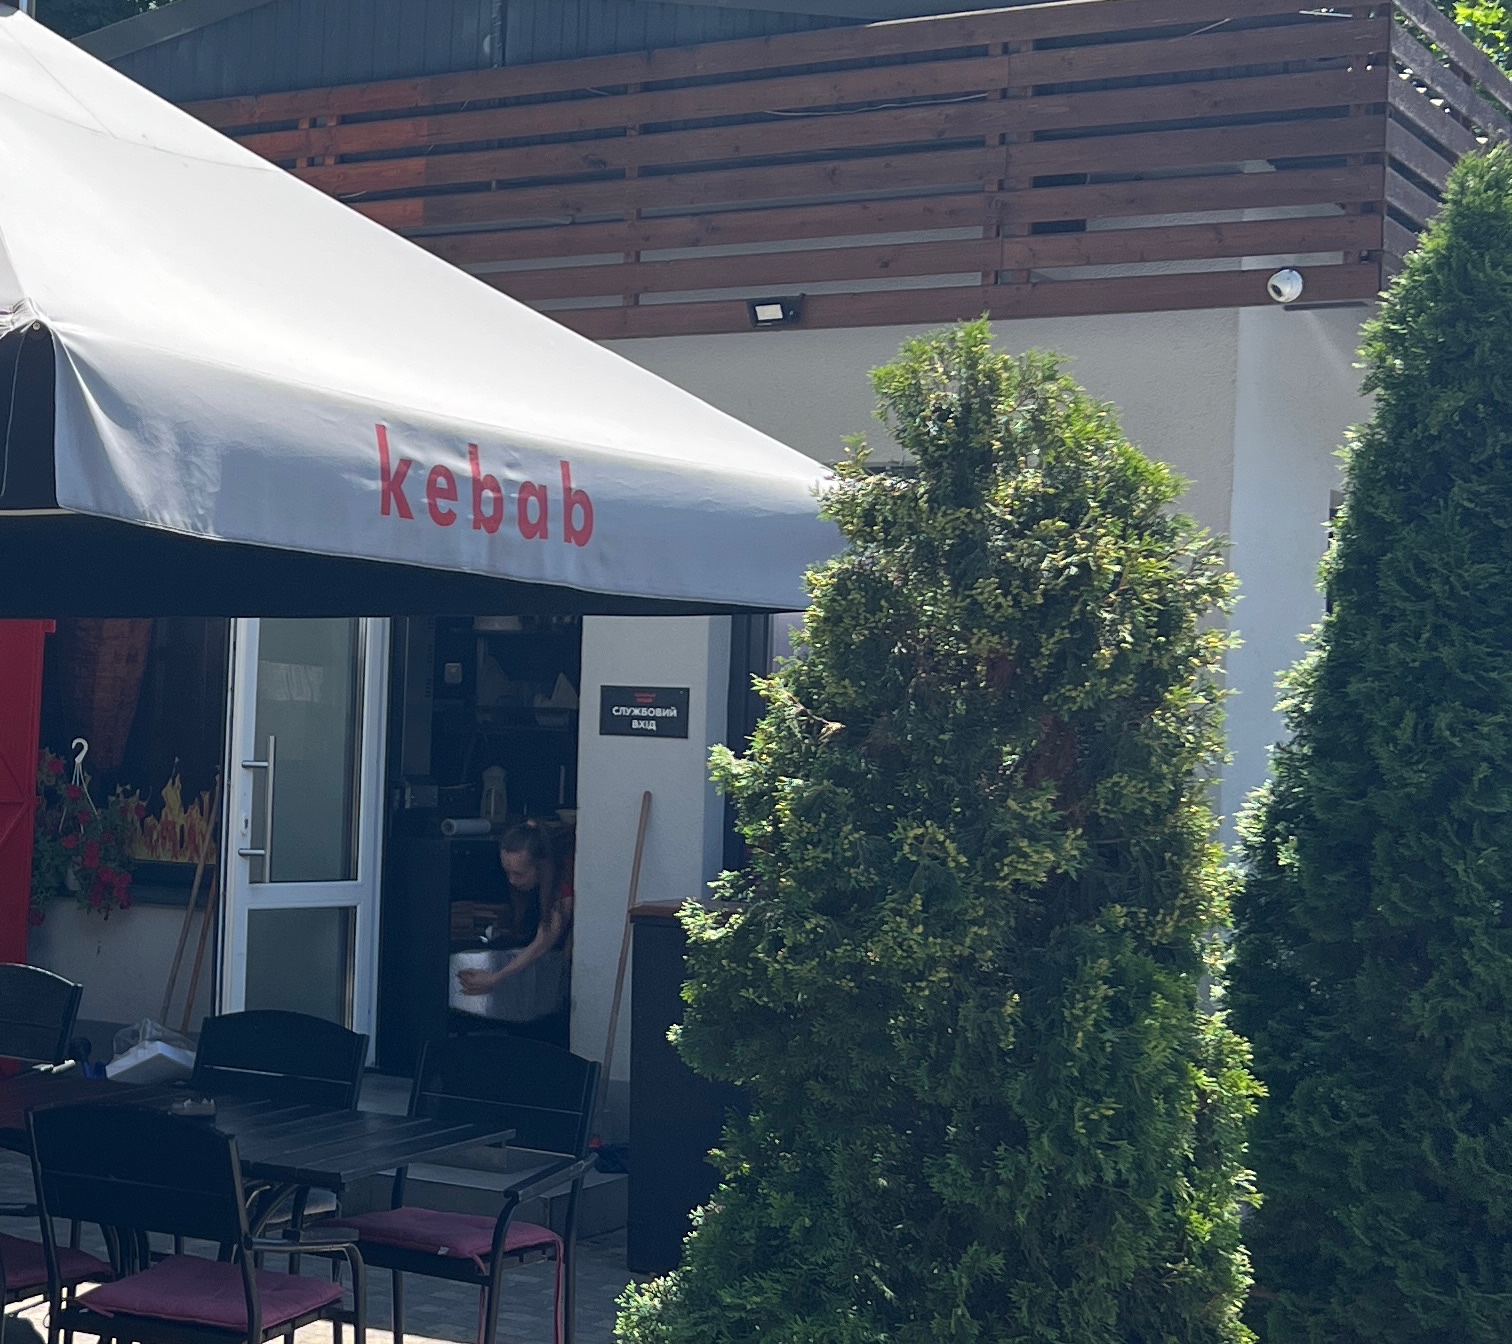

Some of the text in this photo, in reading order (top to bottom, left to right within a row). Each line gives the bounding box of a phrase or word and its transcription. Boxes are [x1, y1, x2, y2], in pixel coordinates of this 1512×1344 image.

[375, 423, 594, 547] kebab
[612, 706, 678, 717] СЛУЖБОВИЙ
[631, 719, 657, 731] ВХІД
